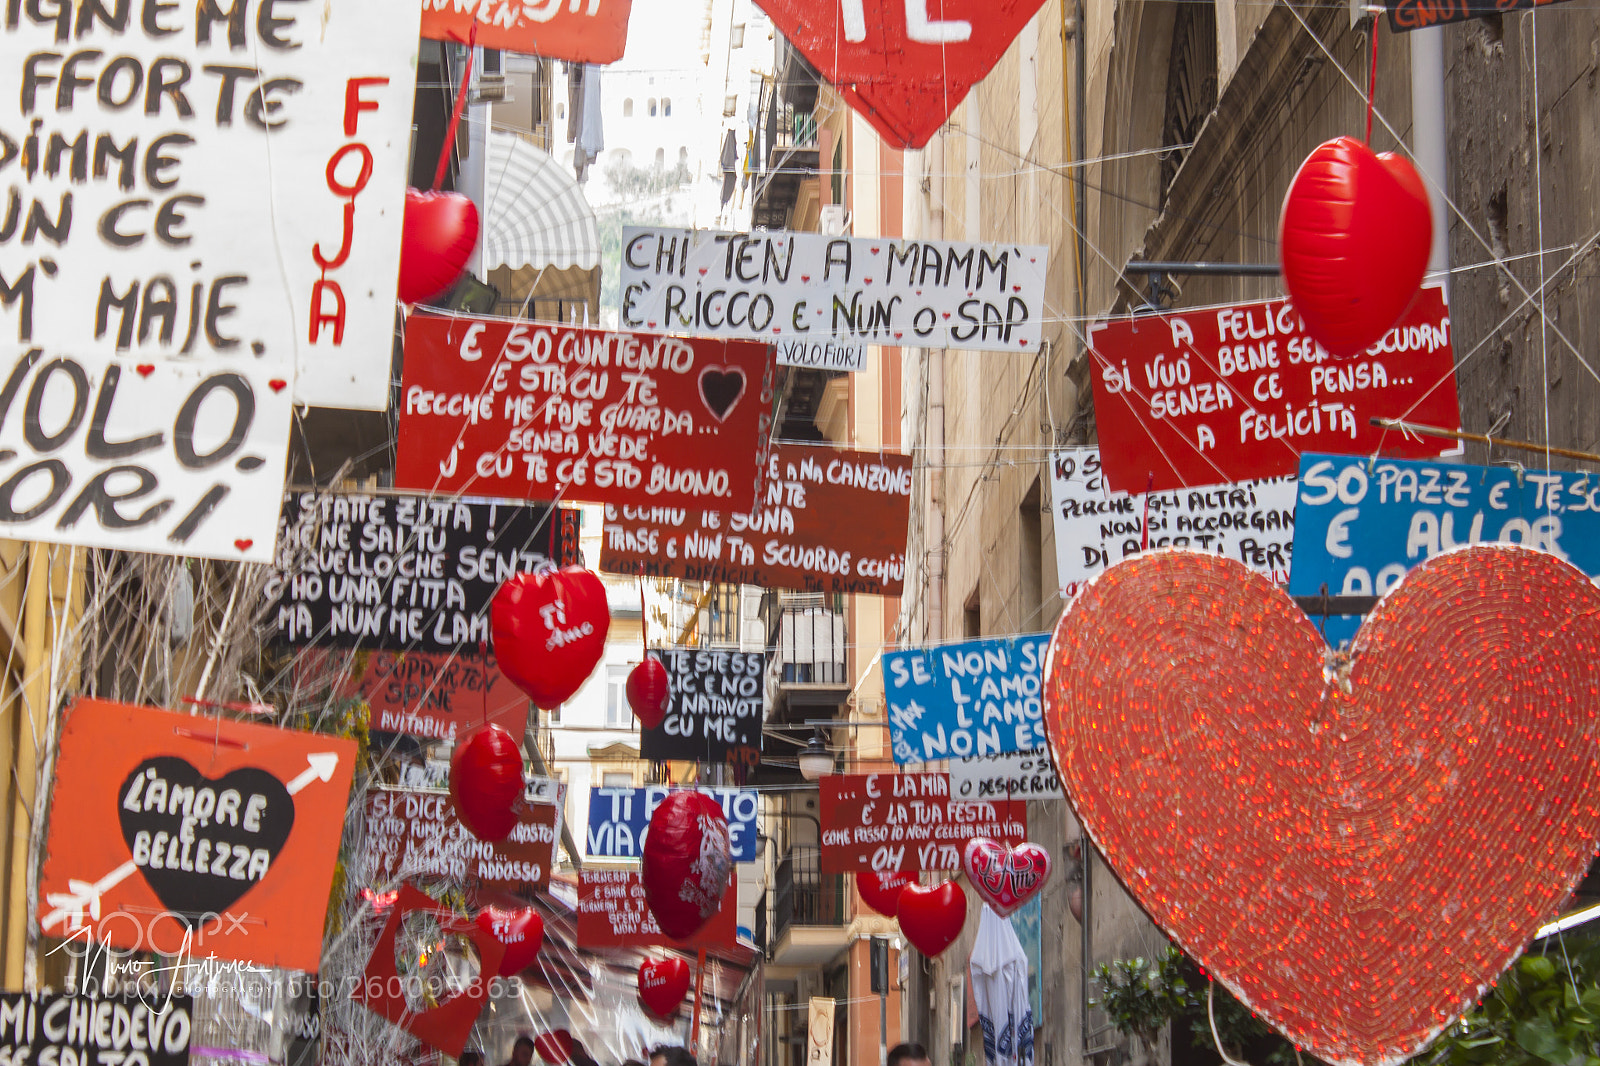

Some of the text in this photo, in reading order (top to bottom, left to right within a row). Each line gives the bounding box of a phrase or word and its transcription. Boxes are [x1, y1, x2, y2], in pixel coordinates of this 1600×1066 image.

[20, 50, 304, 132] FFORTE
[97, 194, 205, 248] CE
[714, 233, 794, 285] TEN
[823, 240, 852, 285] A
[792, 301, 811, 333] E
[913, 307, 937, 337] O
[950, 296, 1030, 345] SAP
[1171, 304, 1306, 349] A FELIC
[459, 322, 486, 361] E
[557, 331, 695, 374] CUNTENTO
[1218, 340, 1281, 378] BENE
[492, 362, 512, 393] E
[570, 370, 609, 400] CU
[621, 373, 658, 405] TE
[1149, 381, 1234, 420] SENZA
[1253, 373, 1283, 401] CE
[504, 394, 536, 426] ME
[545, 394, 593, 431] FAJE
[506, 427, 579, 455] SENZA
[1197, 424, 1216, 452] A
[476, 452, 513, 478] CU
[522, 452, 548, 483] TE
[556, 459, 588, 486] CE
[594, 460, 643, 489] STO
[645, 462, 732, 498] BUONO.
[826, 458, 912, 496] CANZONE
[1376, 464, 1472, 508] PAZZ
[1488, 481, 1511, 510] E
[396, 498, 472, 533] ZITTA
[1100, 515, 1142, 539] NON
[1325, 507, 1360, 559] E
[321, 522, 447, 553] NE SAI TU
[603, 523, 660, 555] TRASE
[684, 529, 723, 560] NUN
[763, 538, 851, 575] SCUORDE
[398, 552, 446, 578] CHE
[292, 573, 323, 602] HO
[329, 574, 381, 606] UNA
[278, 603, 313, 642] MA
[389, 608, 423, 643] ME
[433, 610, 494, 645] LAM
[694, 650, 761, 677] STESS
[890, 647, 1008, 689] SE NON
[663, 714, 695, 738] CU
[921, 722, 1001, 760] NON
[893, 775, 917, 798] LA
[886, 802, 909, 826] LA
[909, 801, 942, 825] TUA
[947, 800, 997, 823] FESTA
[132, 829, 271, 881] BELLEZZA
[587, 820, 635, 857] VIA
[478, 861, 541, 882] ADDOSSO
